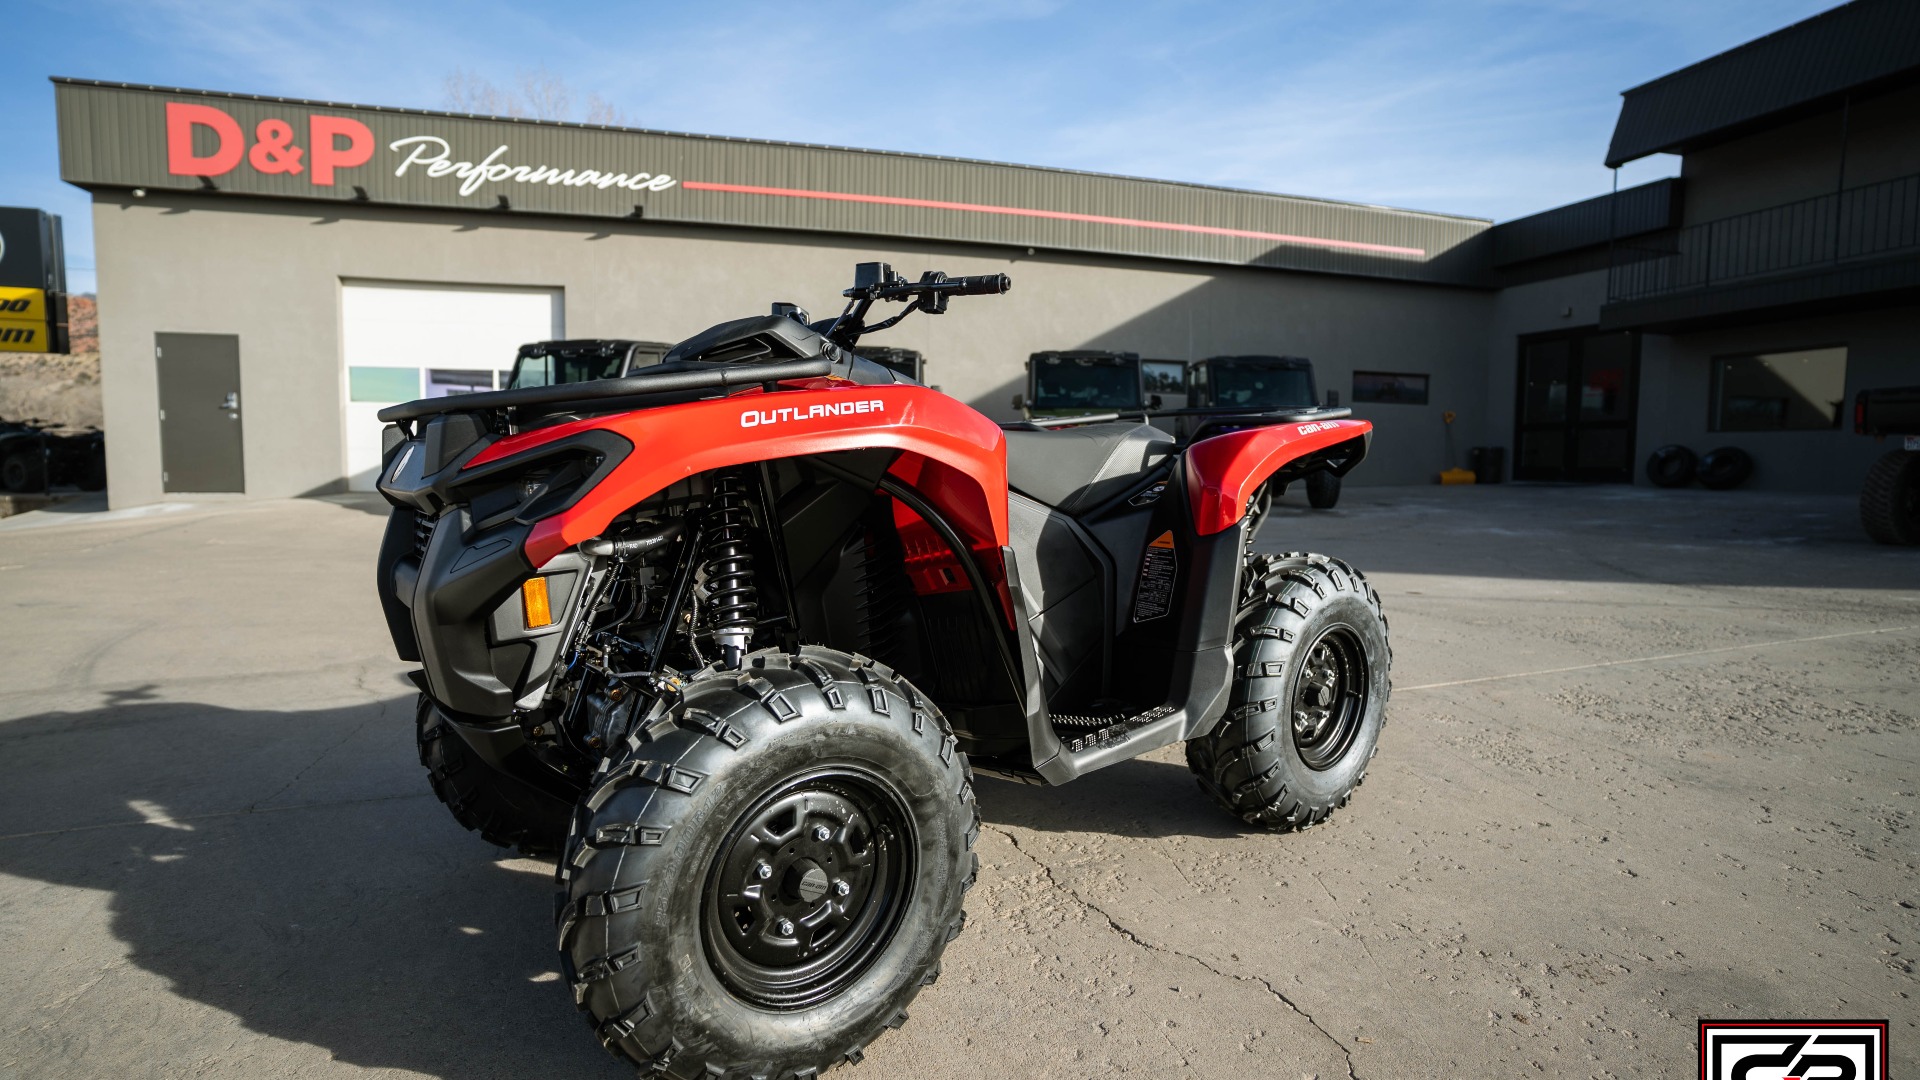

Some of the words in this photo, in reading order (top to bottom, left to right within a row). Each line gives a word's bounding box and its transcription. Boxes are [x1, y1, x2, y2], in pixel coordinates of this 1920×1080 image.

[165, 102, 375, 186] D&P
[389, 136, 677, 196] Performance
[740, 400, 884, 428] OUTLANDER
[1297, 421, 1340, 435] can-am
